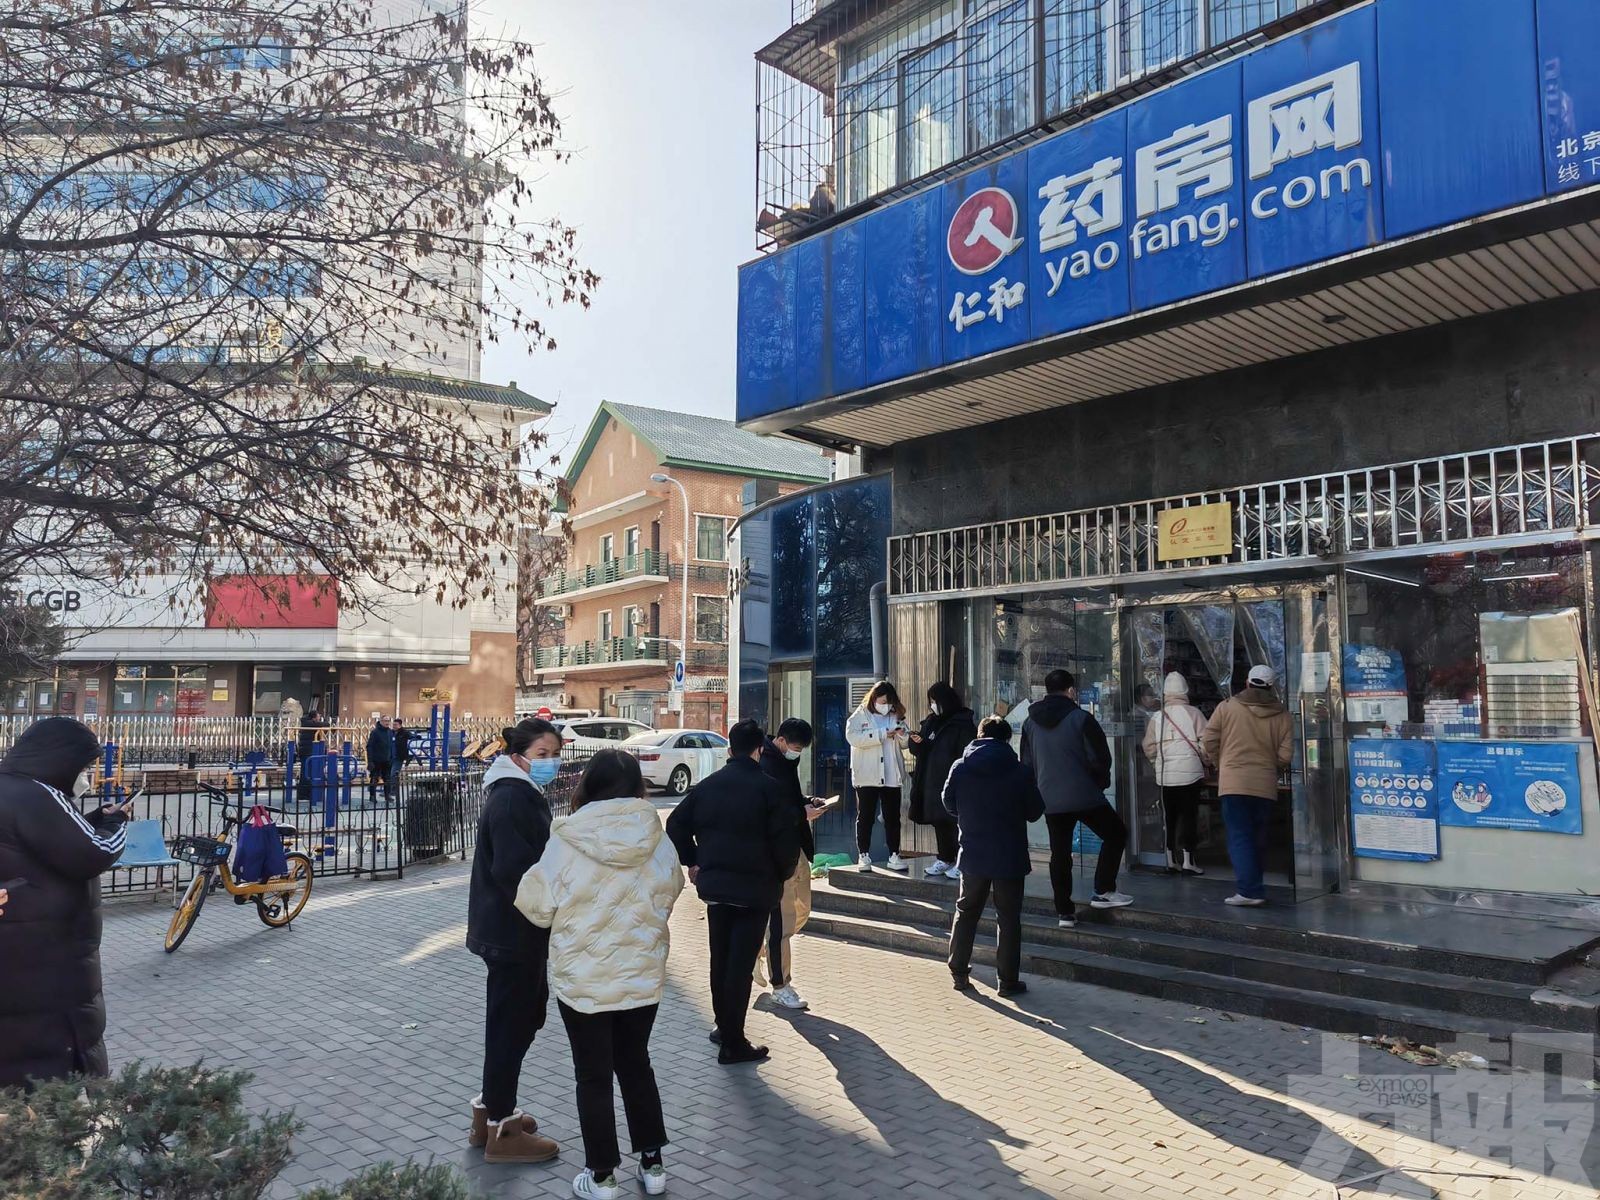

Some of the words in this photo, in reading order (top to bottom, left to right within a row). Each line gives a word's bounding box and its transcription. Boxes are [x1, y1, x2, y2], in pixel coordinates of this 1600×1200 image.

[1038, 61, 1362, 253] 药房网
[1556, 131, 1600, 158] 北京
[1558, 156, 1600, 184] 线下
[948, 276, 1026, 333] 仁和
[27, 590, 81, 611] CGB
